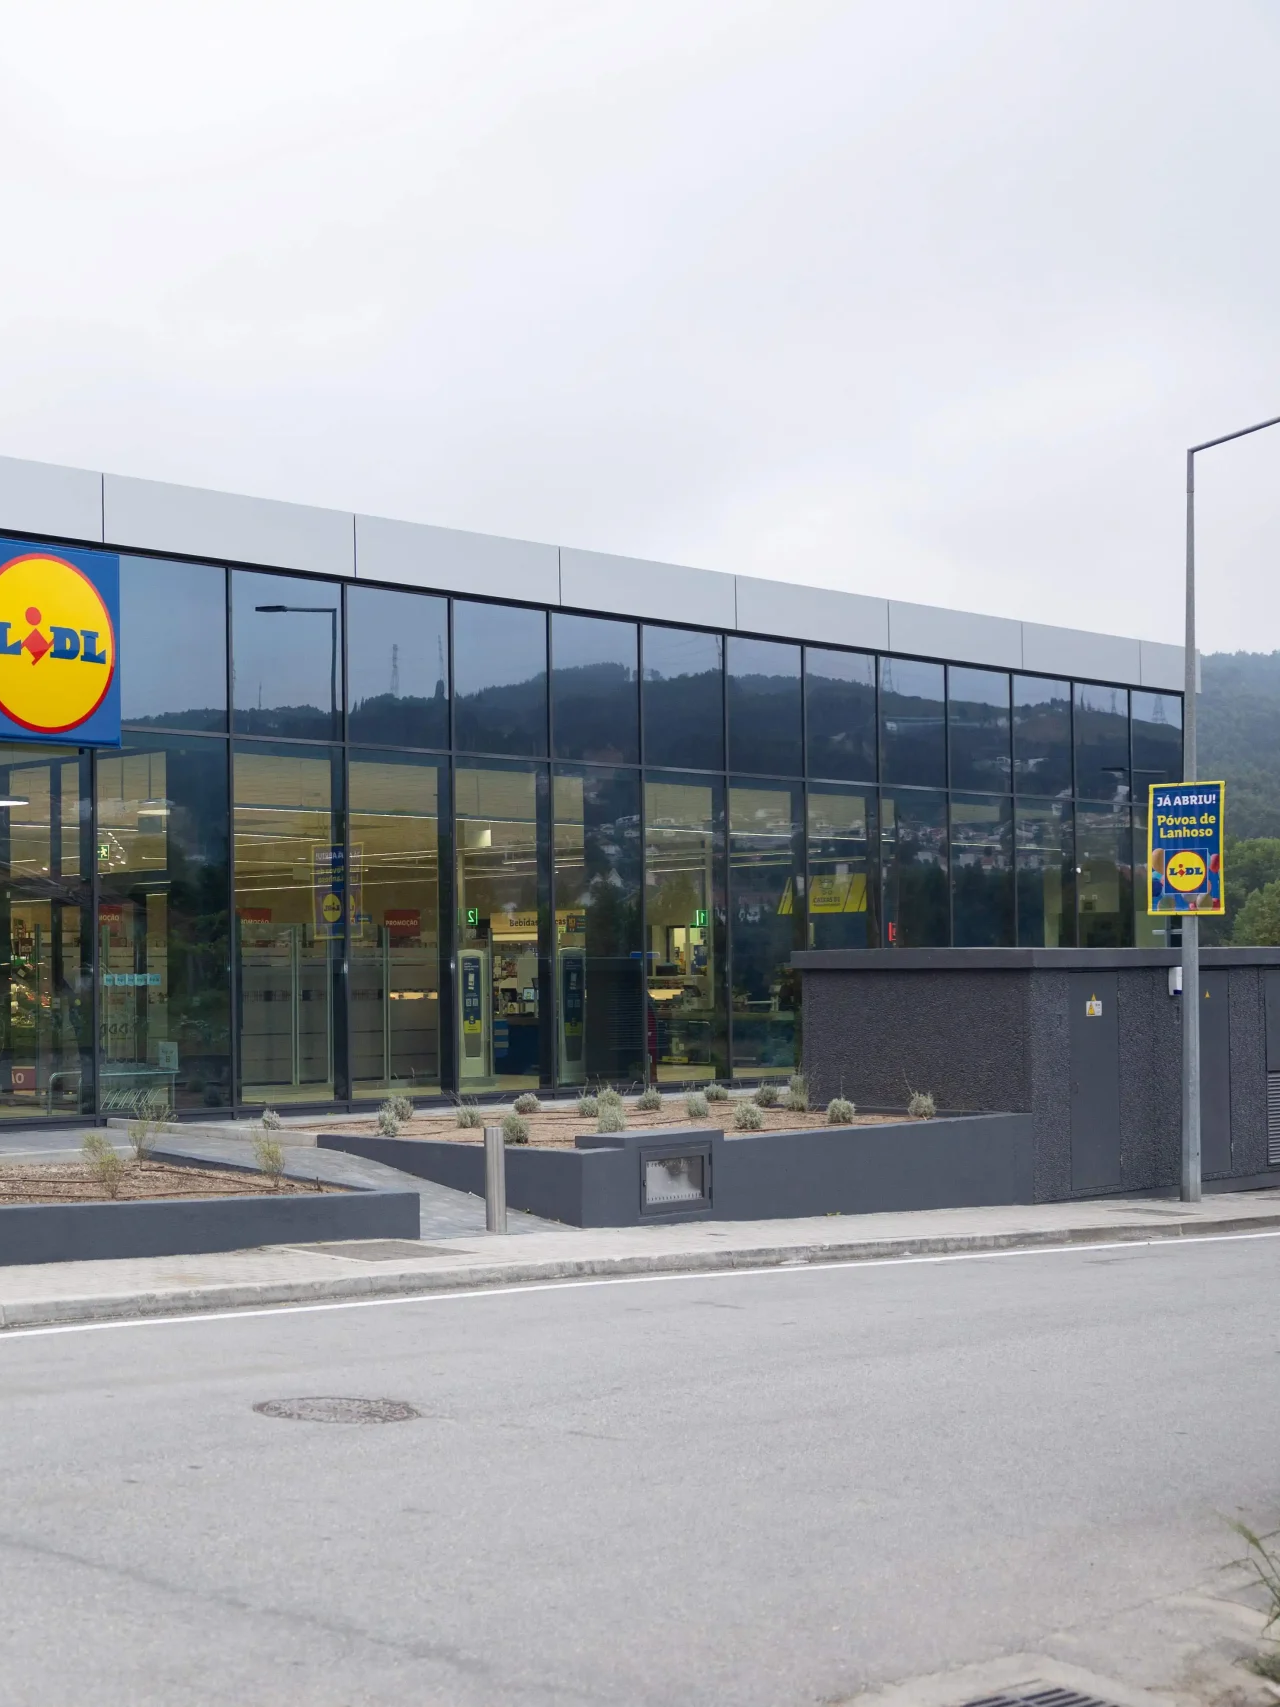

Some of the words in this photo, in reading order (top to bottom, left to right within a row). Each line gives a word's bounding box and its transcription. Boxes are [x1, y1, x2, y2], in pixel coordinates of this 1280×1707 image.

[1157, 795, 1172, 807] JÁ
[1173, 794, 1217, 806] ABRIU!
[1157, 815, 1197, 826] Póvoa
[1200, 813, 1216, 824] de
[1159, 827, 1214, 838] Lanhoso
